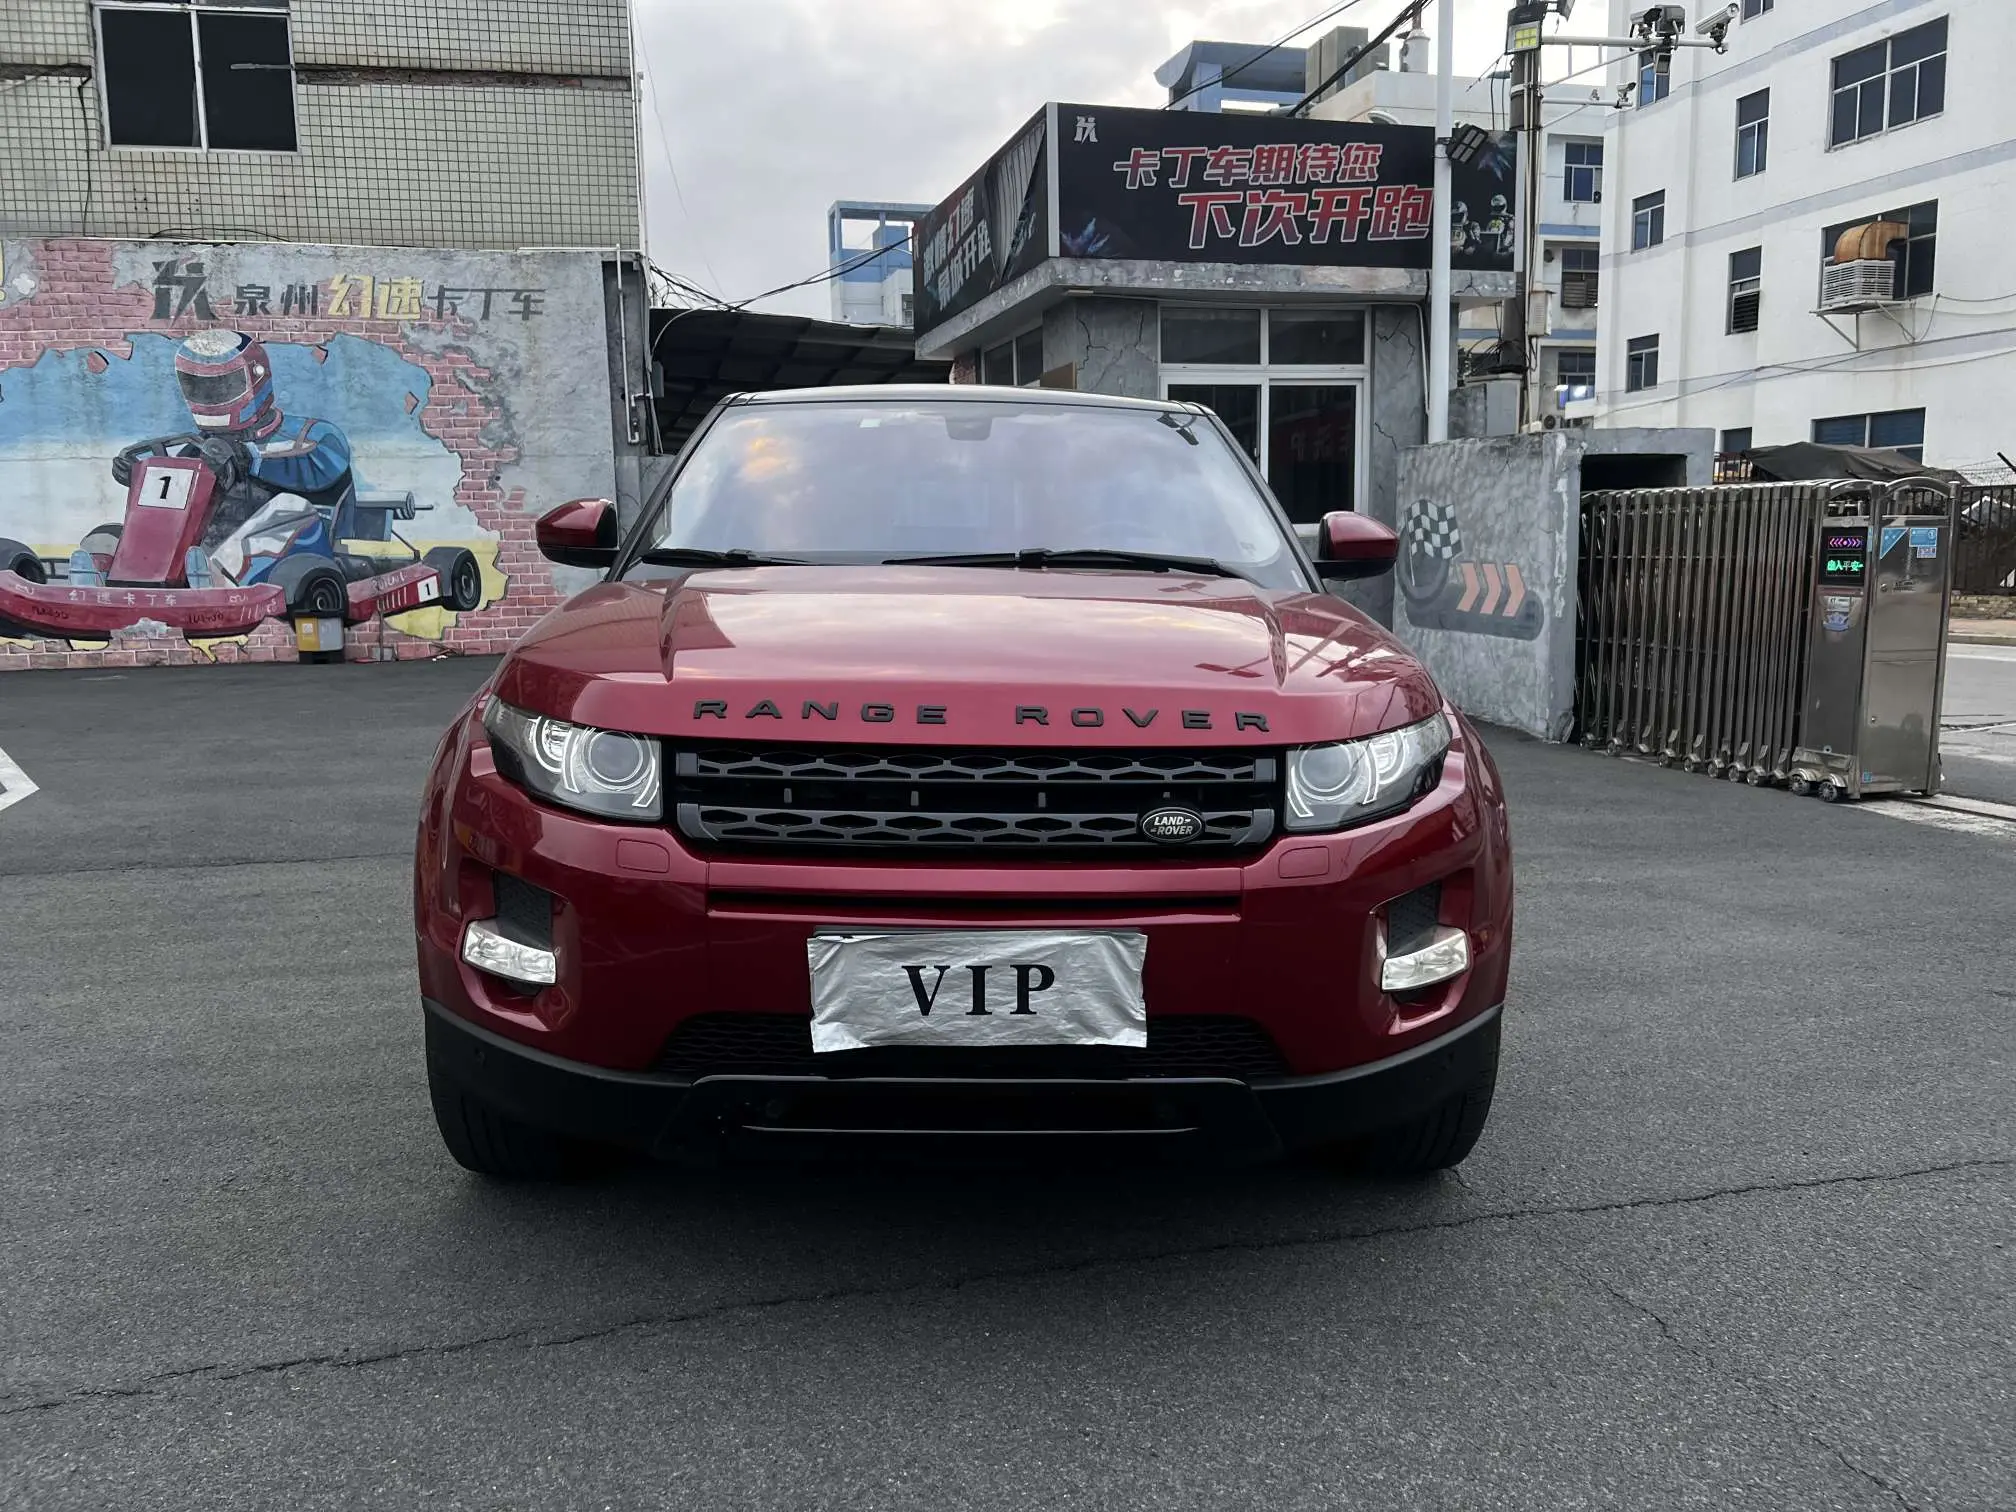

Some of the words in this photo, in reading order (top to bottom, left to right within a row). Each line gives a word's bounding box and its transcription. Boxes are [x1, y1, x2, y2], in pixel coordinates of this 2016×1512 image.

[1113, 142, 1383, 189] 卡丁车期待您
[1178, 184, 1433, 249] 下次开跑
[234, 274, 546, 321] 泉州幻速卡丁车
[158, 475, 172, 500] 1
[425, 583, 431, 596] 1
[693, 698, 949, 726] RANGE
[1015, 704, 1271, 732] ROVER
[1153, 816, 1184, 826] LAND
[1157, 825, 1193, 836] ROVER
[900, 964, 1056, 1016] VIP
